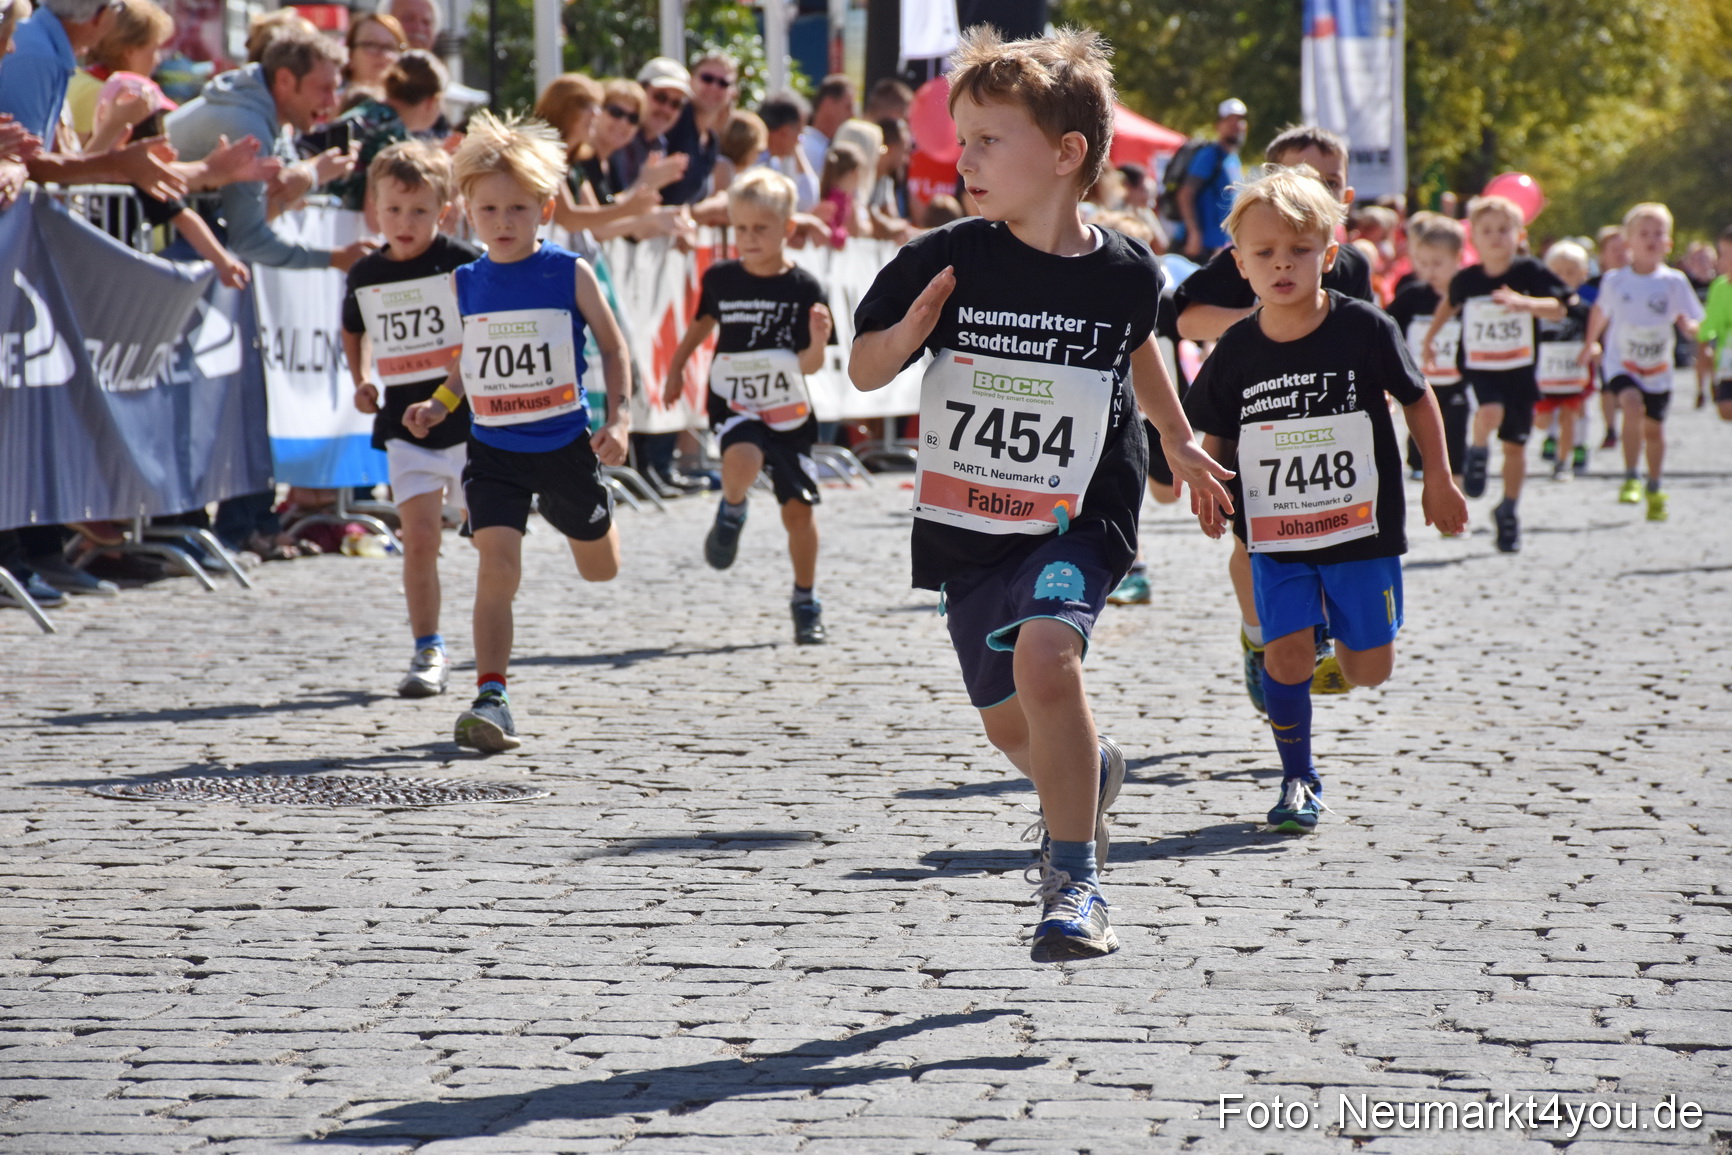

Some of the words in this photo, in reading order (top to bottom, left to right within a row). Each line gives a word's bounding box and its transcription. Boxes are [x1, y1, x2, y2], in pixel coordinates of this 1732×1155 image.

[377, 305, 445, 342] 7573
[489, 321, 538, 336] BOCK
[958, 306, 1087, 333] Neumarkter
[1474, 319, 1523, 342] 7435
[957, 331, 1058, 360] Stadtlauf
[476, 342, 552, 379] 7041
[484, 384, 507, 392] PARTL
[509, 381, 544, 390] Neumarkt
[725, 370, 790, 402] 7574
[971, 389, 997, 399] inspired
[997, 392, 1005, 401] by
[1006, 394, 1025, 403] smart
[1025, 396, 1055, 406] concepts
[973, 370, 1054, 399] BOCK
[1242, 372, 1317, 400] eumarkter
[489, 396, 552, 414] Markuss
[926, 434, 939, 447] B2
[945, 400, 1076, 468] 7454
[1275, 427, 1335, 447] BOCK
[953, 461, 988, 478] PARTL
[990, 468, 1045, 486] Neumarkt
[1259, 450, 1357, 497] 7448
[967, 487, 1036, 518] Fabian
[1273, 502, 1299, 511] PARTL
[1301, 497, 1341, 509] Neumarkt
[1276, 512, 1350, 537] Johannes
